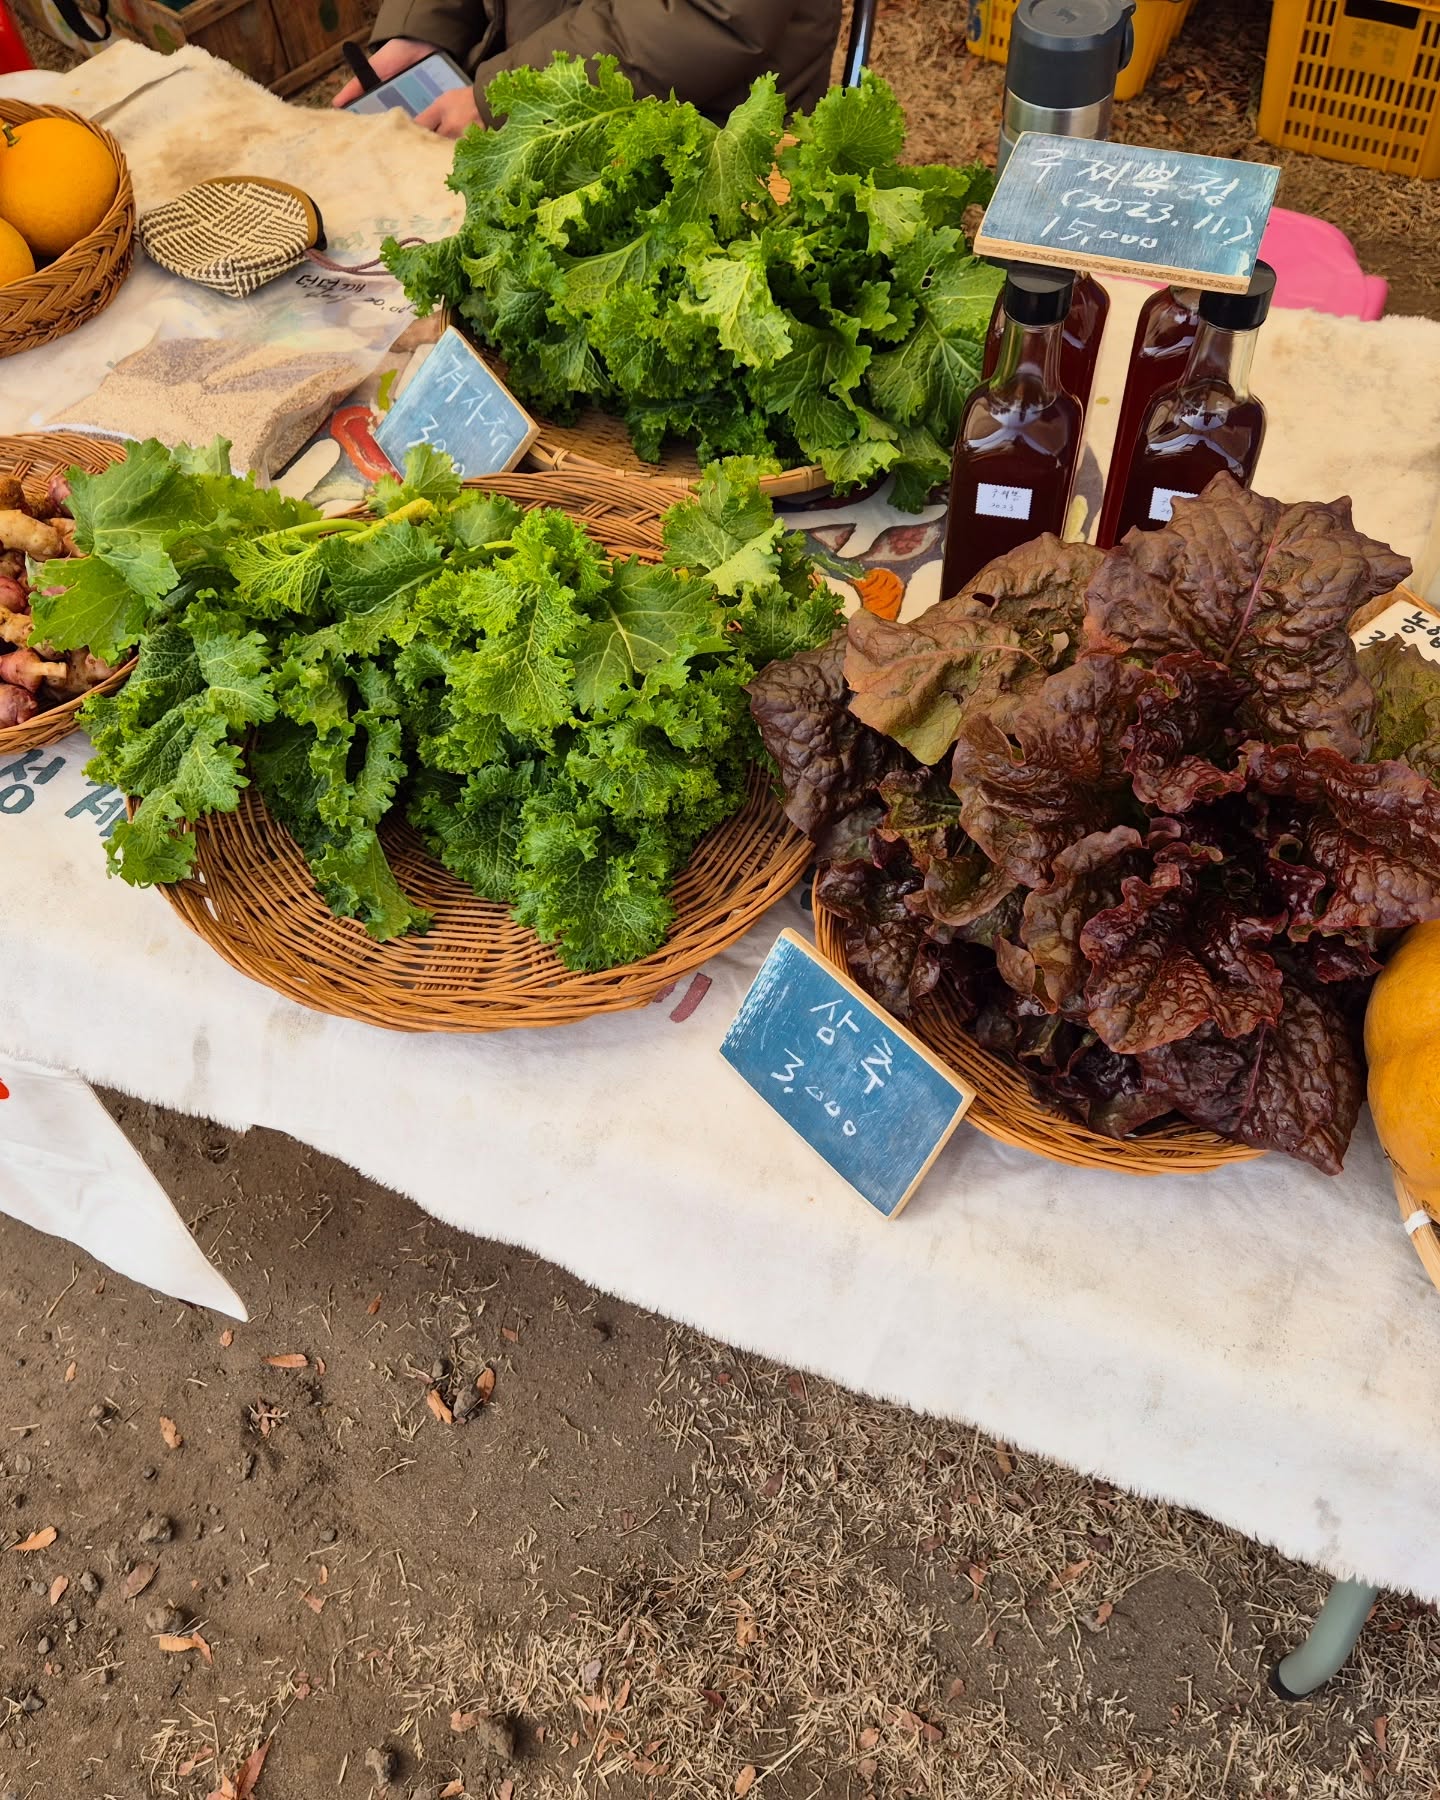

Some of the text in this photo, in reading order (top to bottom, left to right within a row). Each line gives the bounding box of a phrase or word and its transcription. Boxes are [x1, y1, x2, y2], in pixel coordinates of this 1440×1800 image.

[1040, 216, 1158, 248] 15,000
[810, 1000, 893, 1094] 상추
[771, 1048, 857, 1136] 3,000
